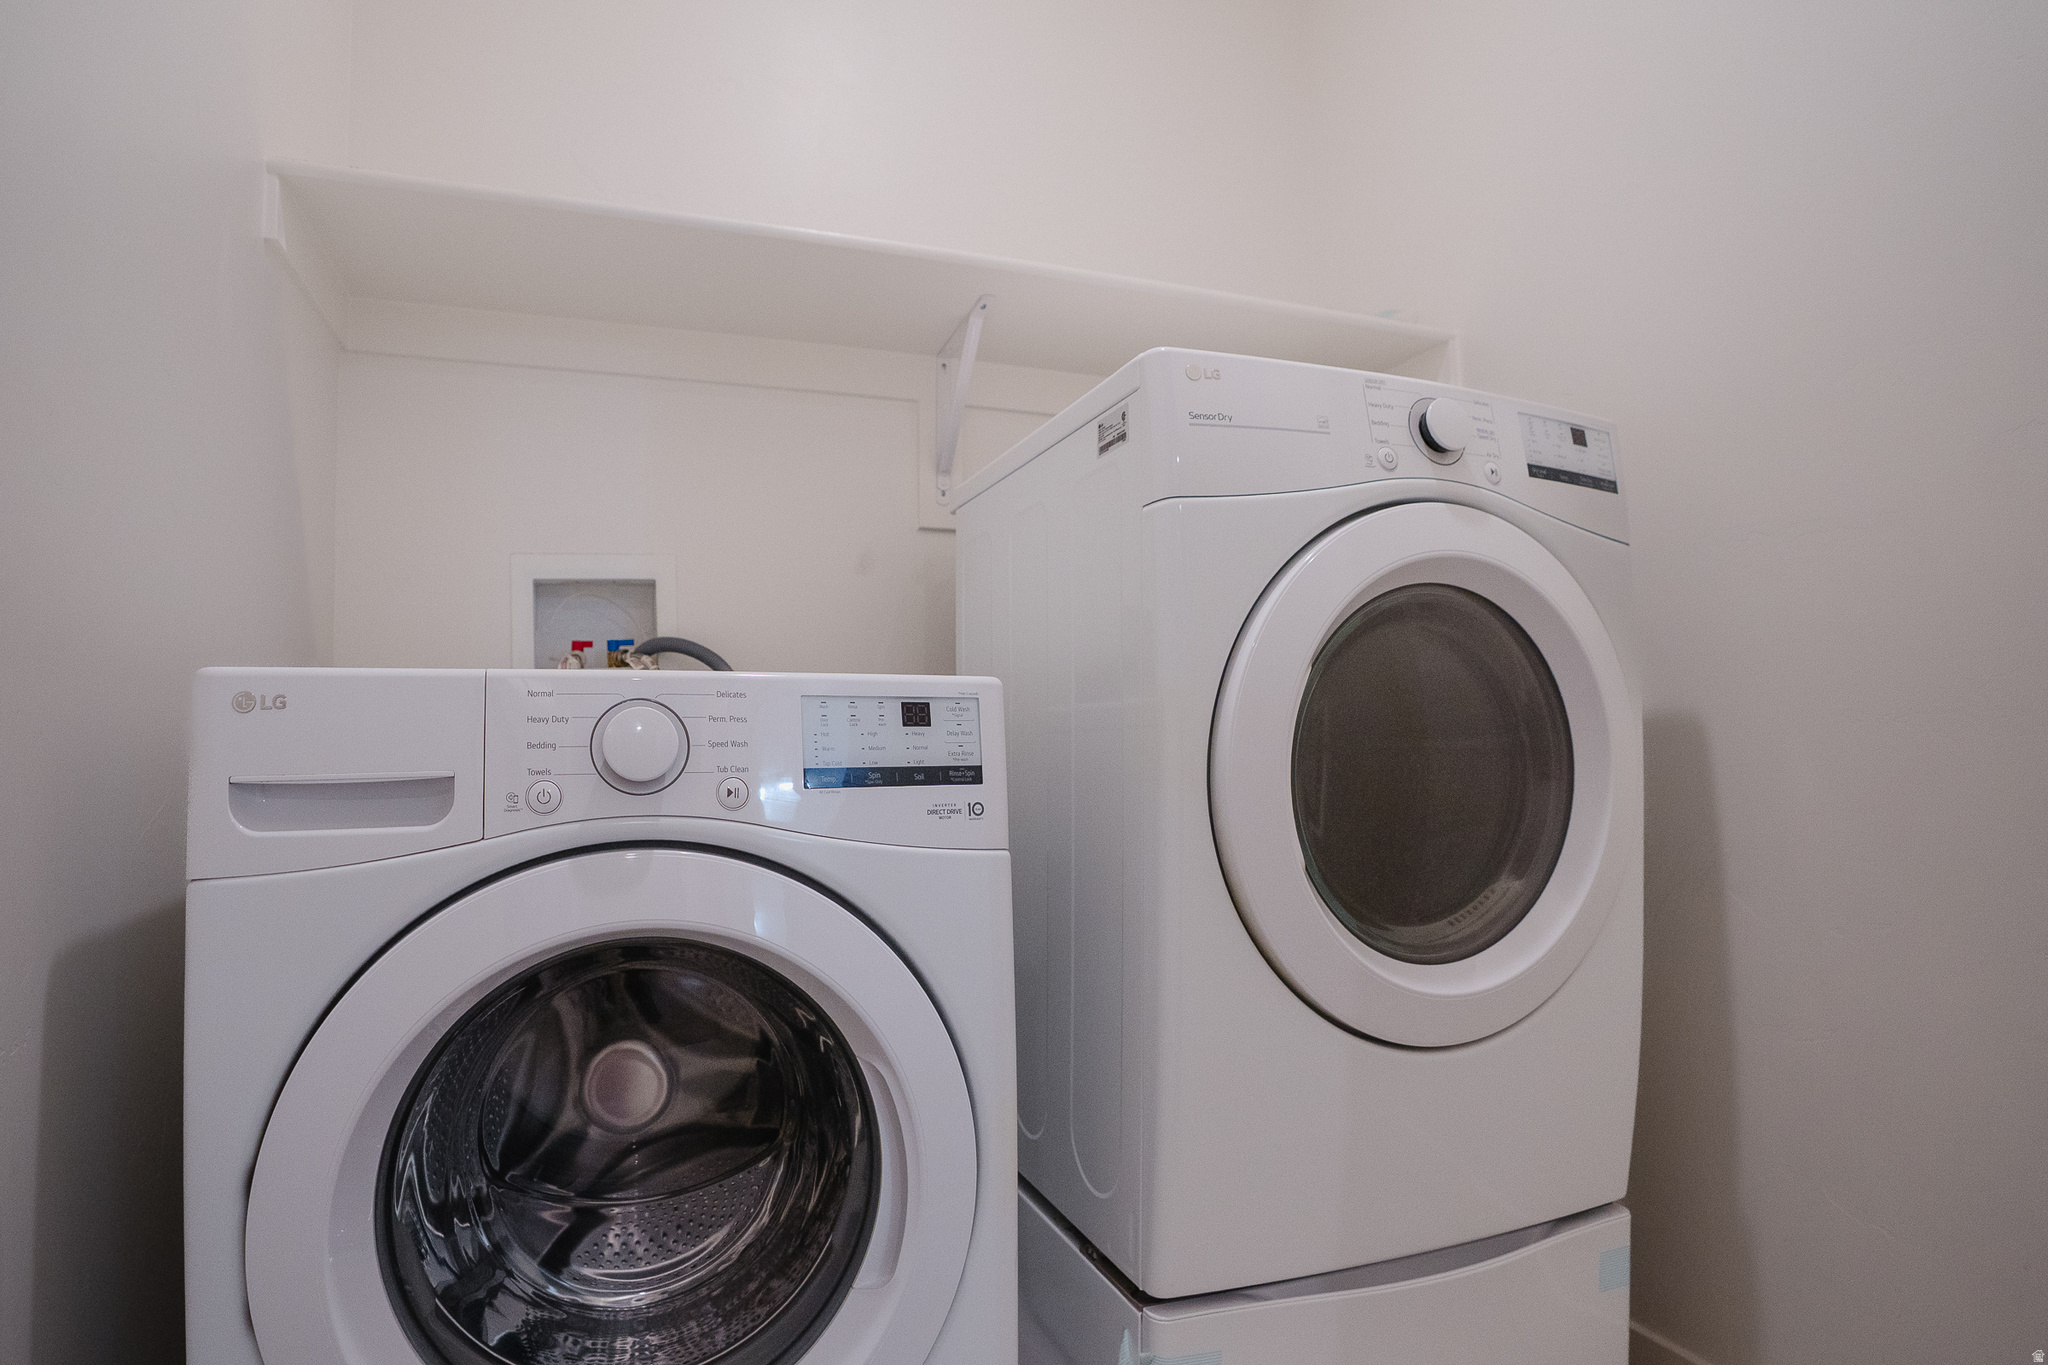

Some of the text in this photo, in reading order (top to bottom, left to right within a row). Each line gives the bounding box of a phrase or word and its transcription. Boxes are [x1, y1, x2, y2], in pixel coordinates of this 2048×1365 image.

[1203, 368, 1221, 380] LG
[716, 691, 747, 699] Delicates
[260, 694, 287, 710] LG
[526, 716, 570, 724] Heavy Duty
[708, 715, 748, 723] Perm. Press
[946, 730, 959, 738] Delay
[526, 741, 557, 751] Bedding
[707, 740, 748, 749] Speed Wash
[527, 768, 552, 776] Towels
[716, 765, 749, 773] Tub Clean
[868, 771, 881, 779] Spin
[913, 772, 925, 780] Soil
[967, 801, 985, 817] 10
